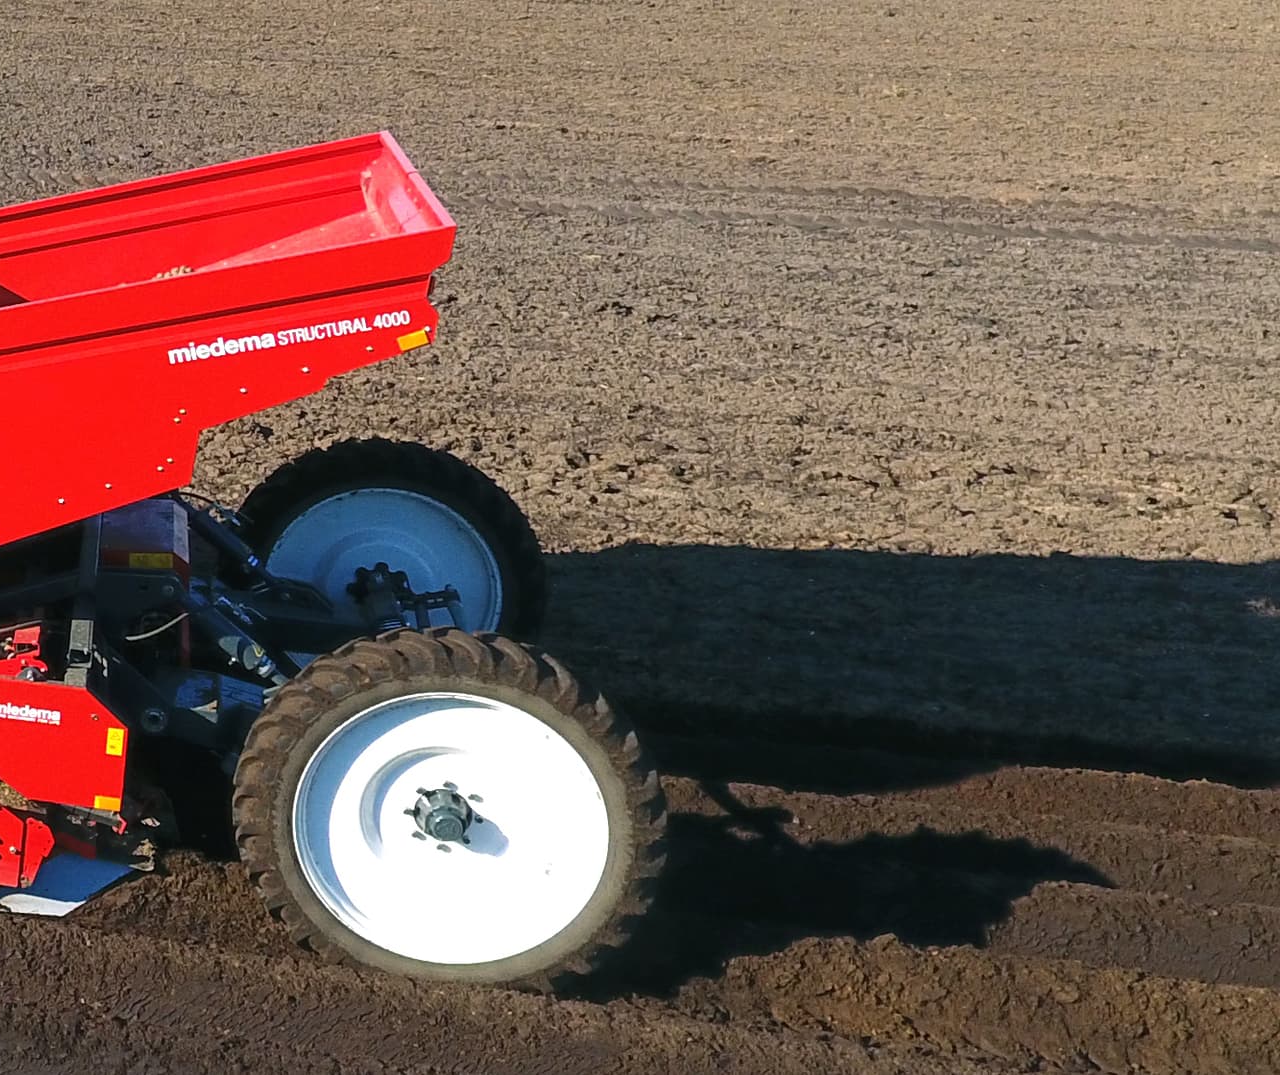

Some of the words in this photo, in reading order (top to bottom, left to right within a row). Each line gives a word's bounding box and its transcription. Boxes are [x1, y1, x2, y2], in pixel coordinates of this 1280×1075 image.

[168, 337, 276, 364] miedema
[277, 317, 373, 346] STRUCTURAL
[373, 310, 411, 329] 4000
